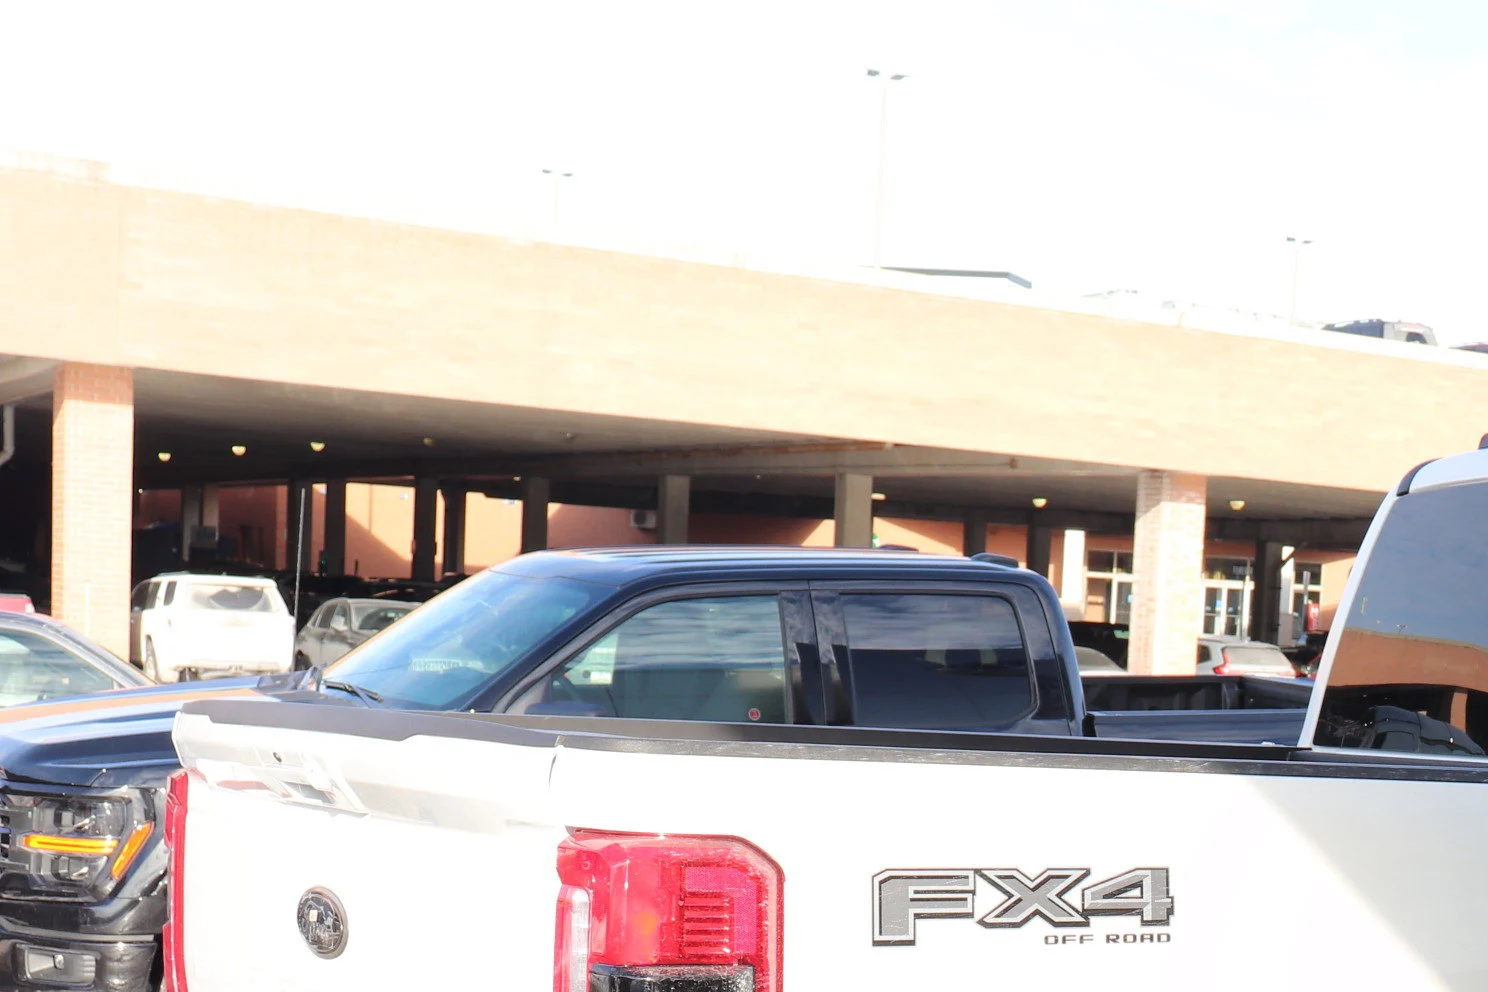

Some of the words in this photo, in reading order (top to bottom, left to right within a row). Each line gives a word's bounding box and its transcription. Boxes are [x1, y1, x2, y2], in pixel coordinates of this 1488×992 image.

[871, 867, 1175, 947] FX4
[1044, 933, 1094, 946] OFF
[1105, 932, 1172, 945] ROAD
